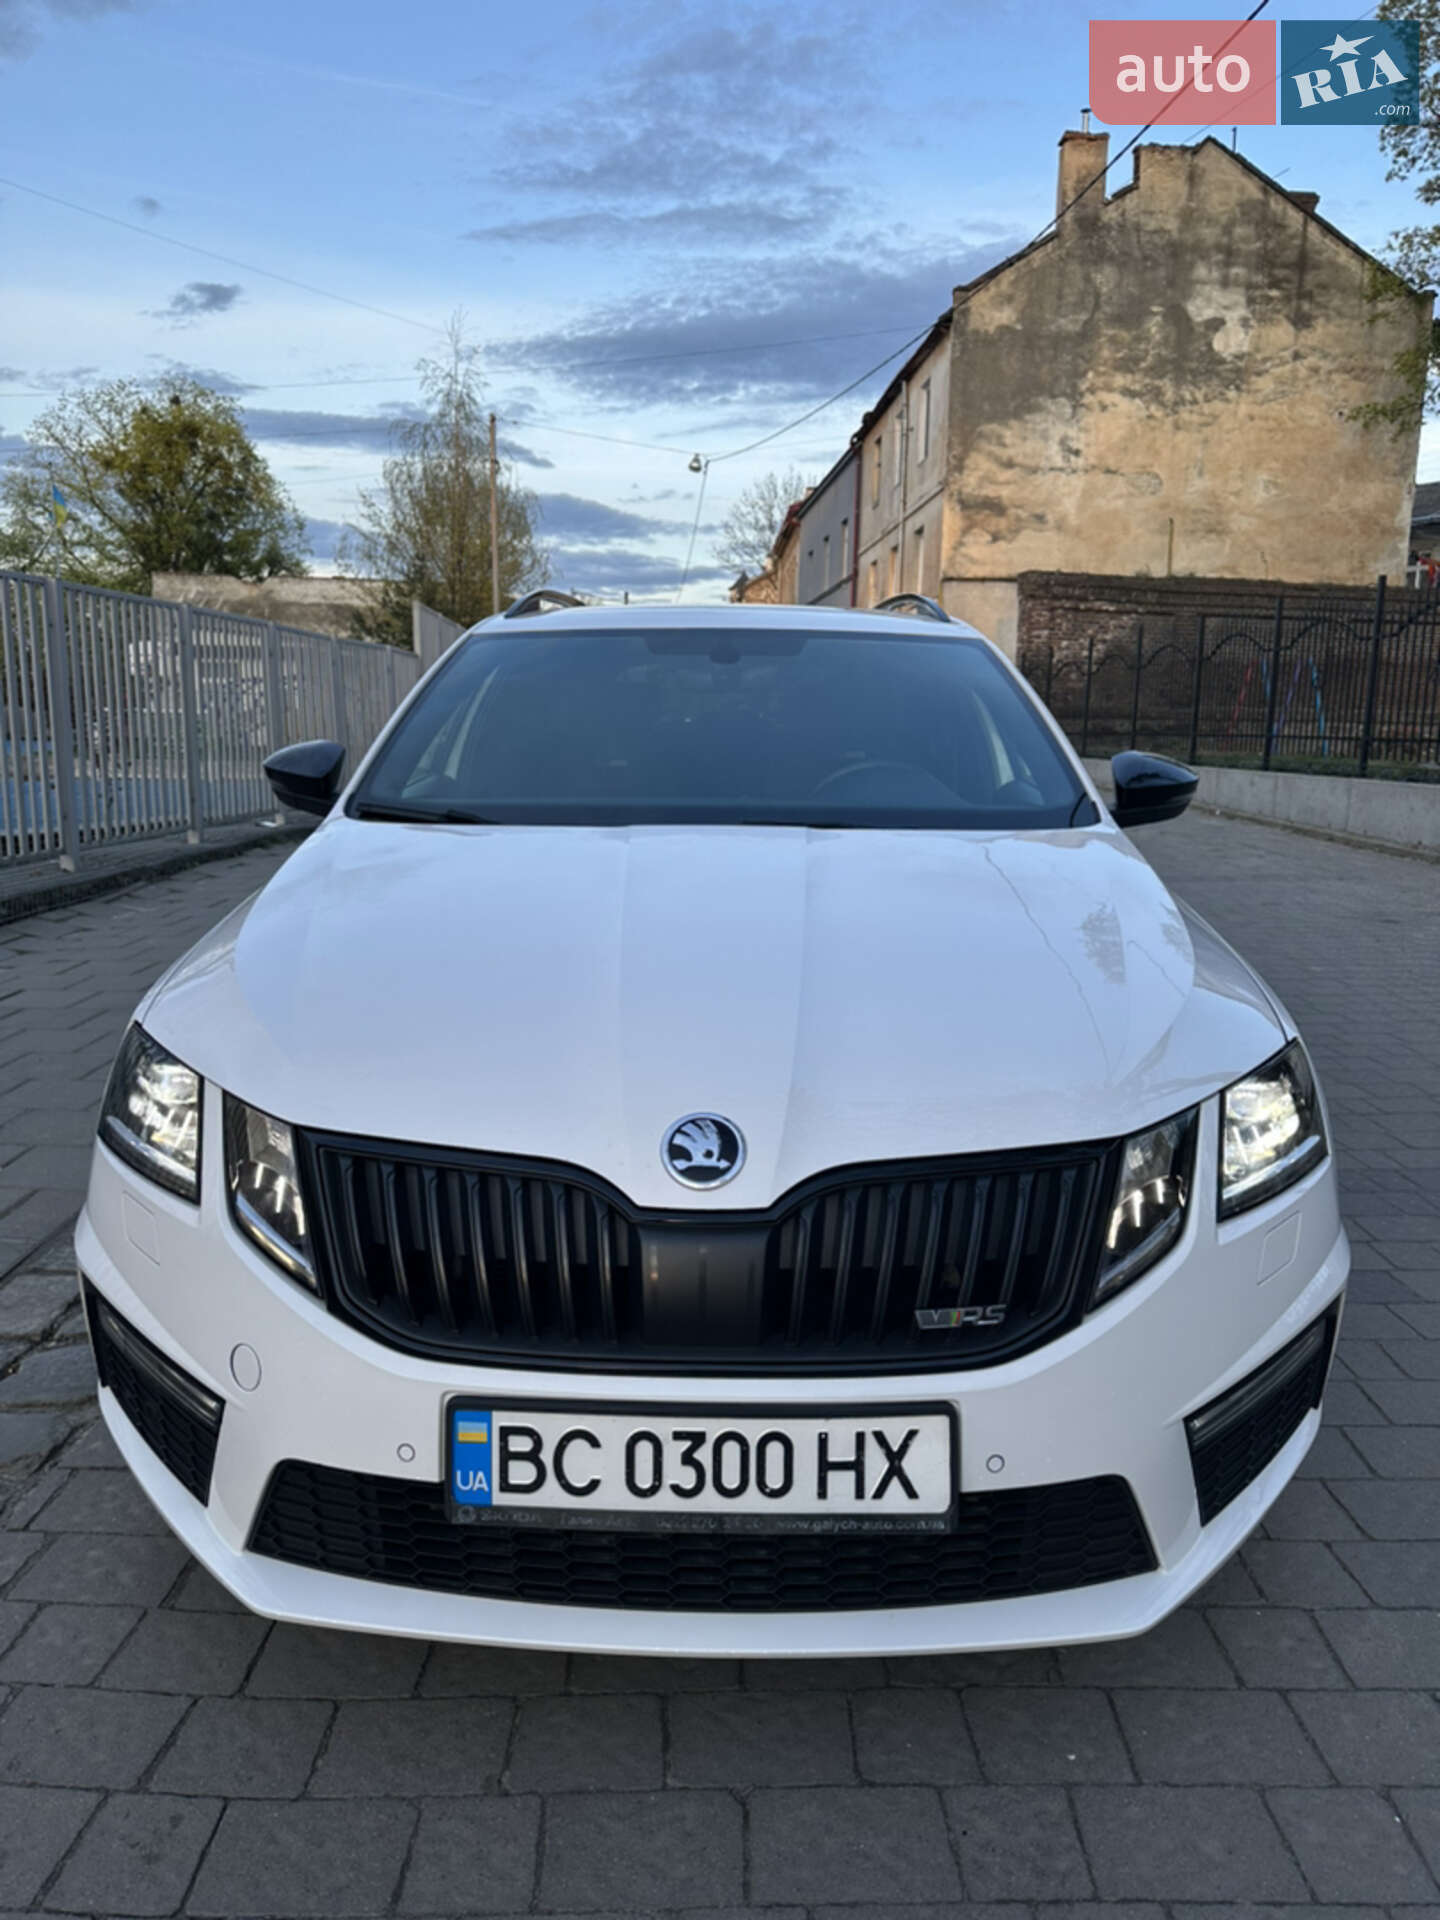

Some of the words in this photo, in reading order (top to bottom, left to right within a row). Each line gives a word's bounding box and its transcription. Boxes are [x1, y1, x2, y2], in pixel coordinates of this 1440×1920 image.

[456, 1470, 489, 1492] UA
[499, 1425, 602, 1497] BC
[624, 1430, 794, 1499] 0300
[817, 1429, 919, 1500] HX
